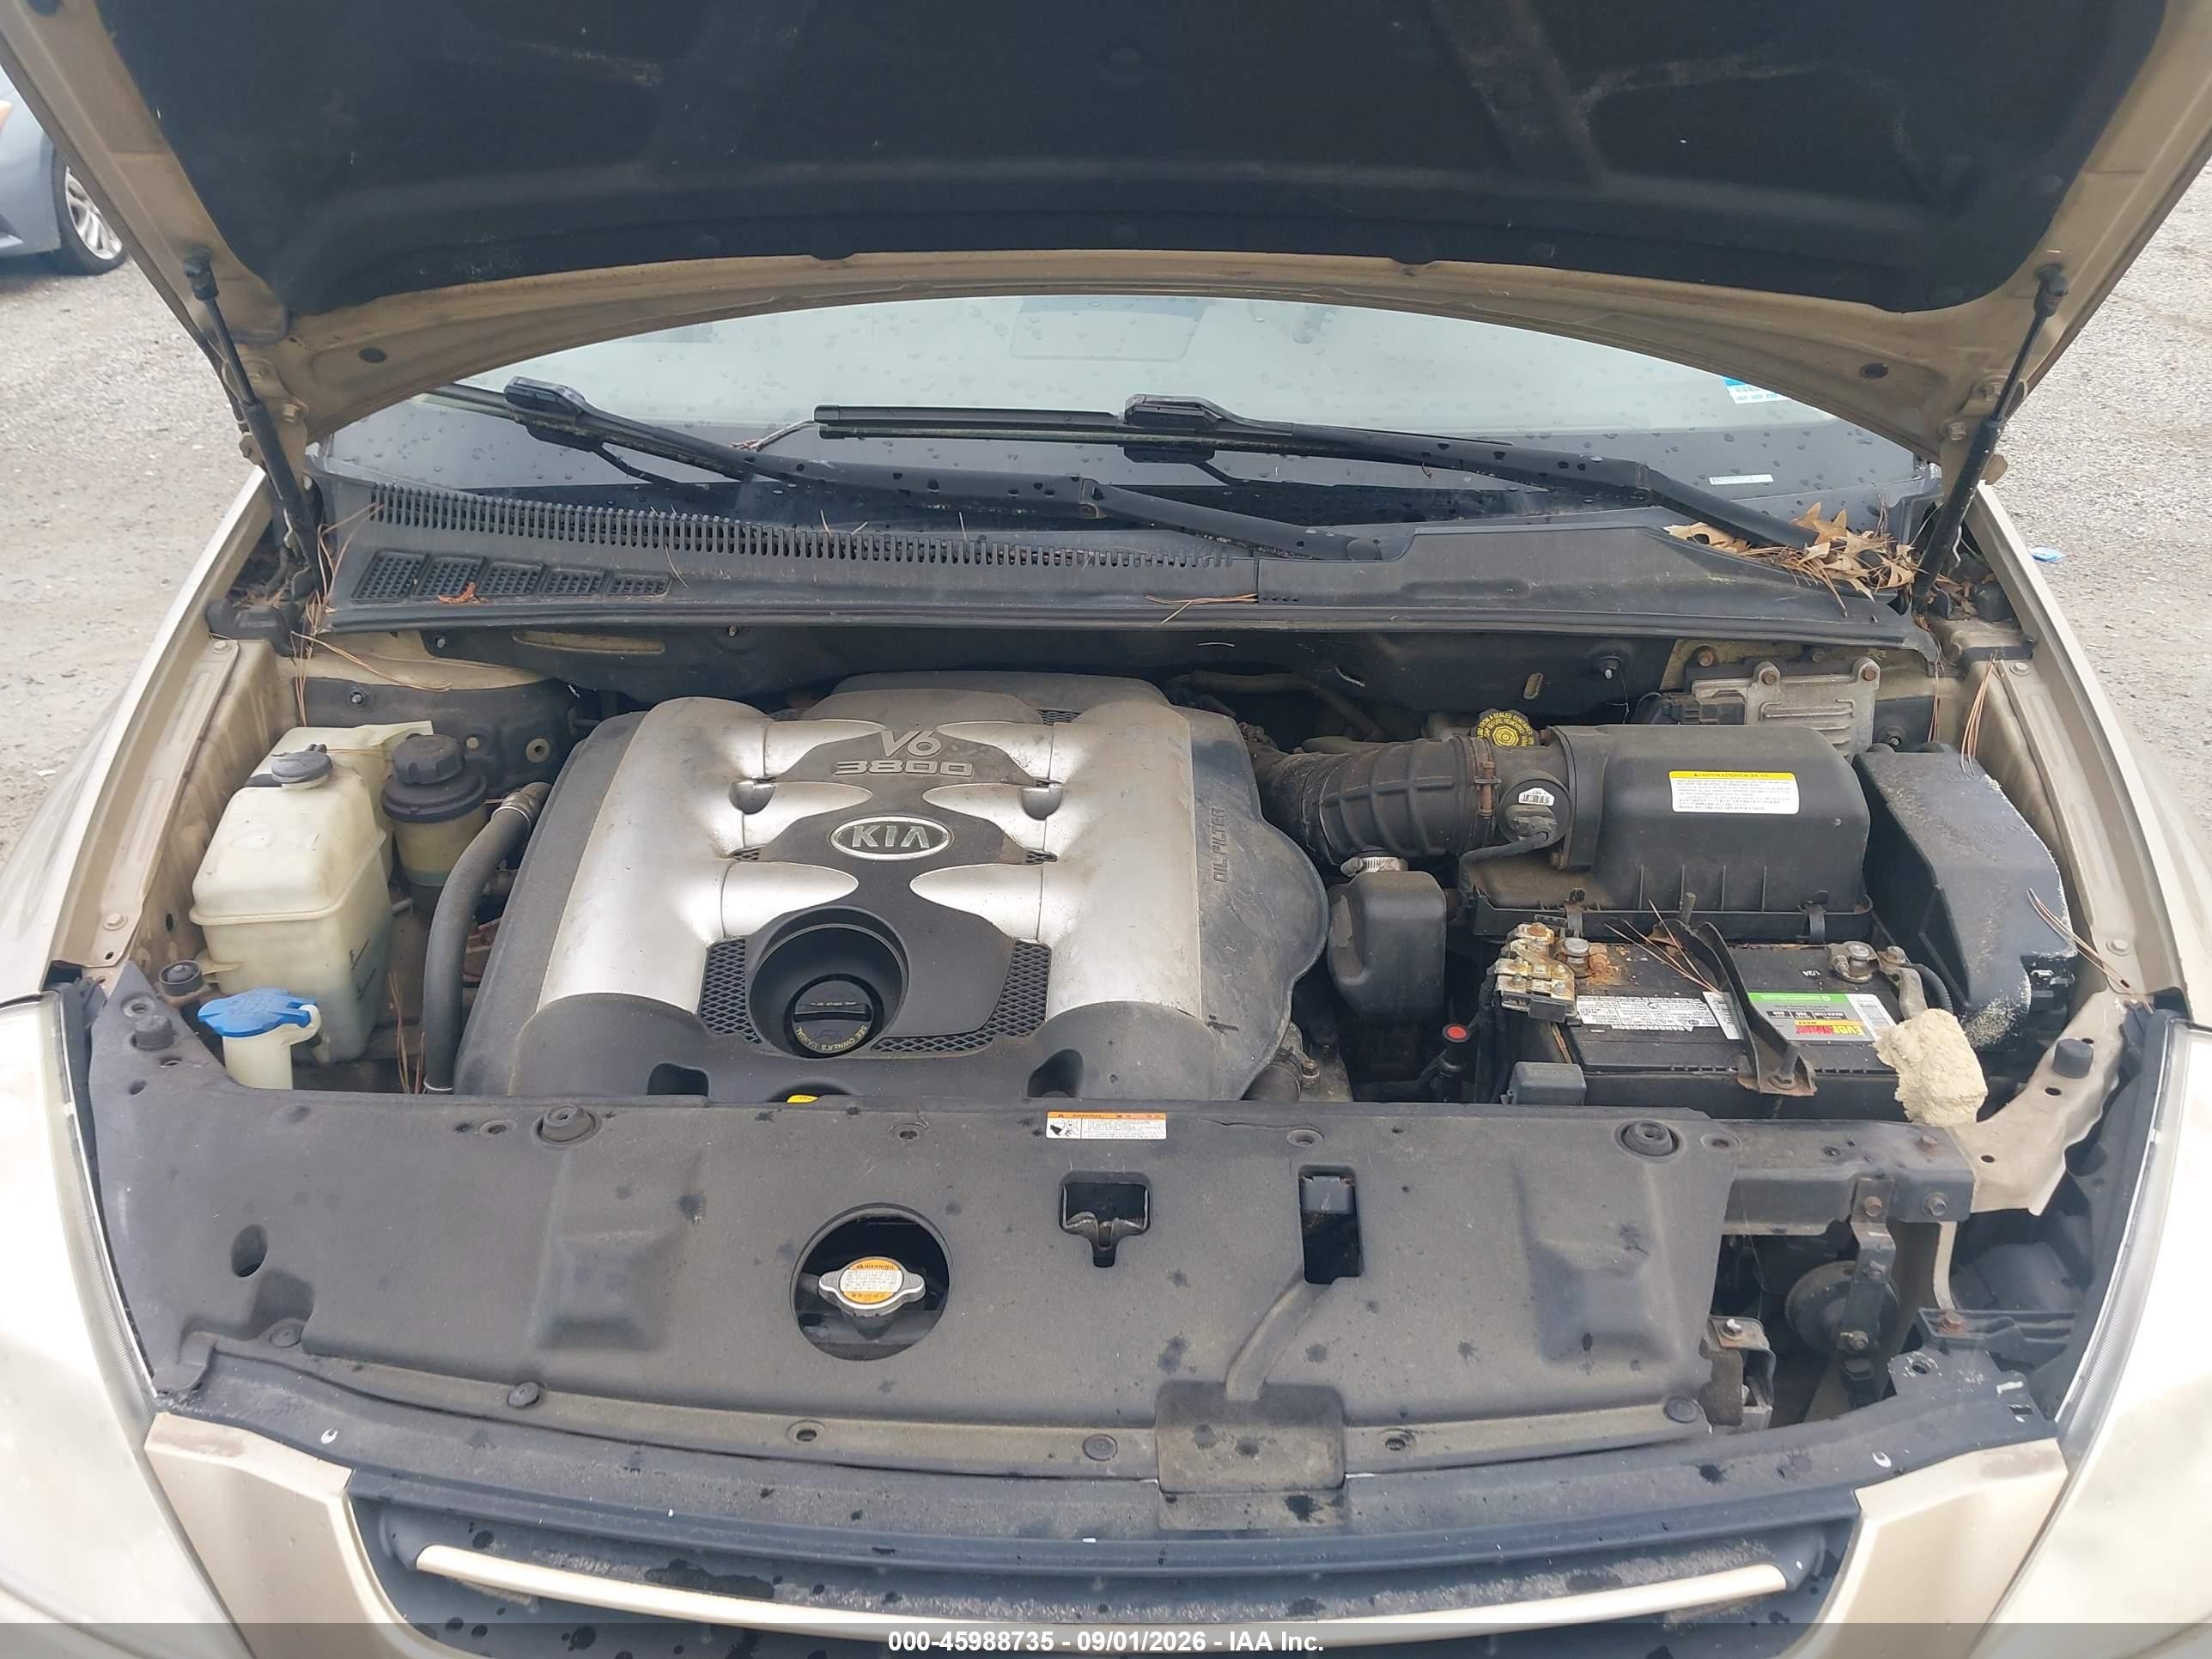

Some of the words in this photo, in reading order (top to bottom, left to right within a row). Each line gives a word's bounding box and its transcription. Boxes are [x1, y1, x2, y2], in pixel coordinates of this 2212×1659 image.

[880, 730, 942, 758] V6
[835, 759, 975, 777] 3800
[851, 824, 930, 848] KIA
[854, 1025, 868, 1039] SEE
